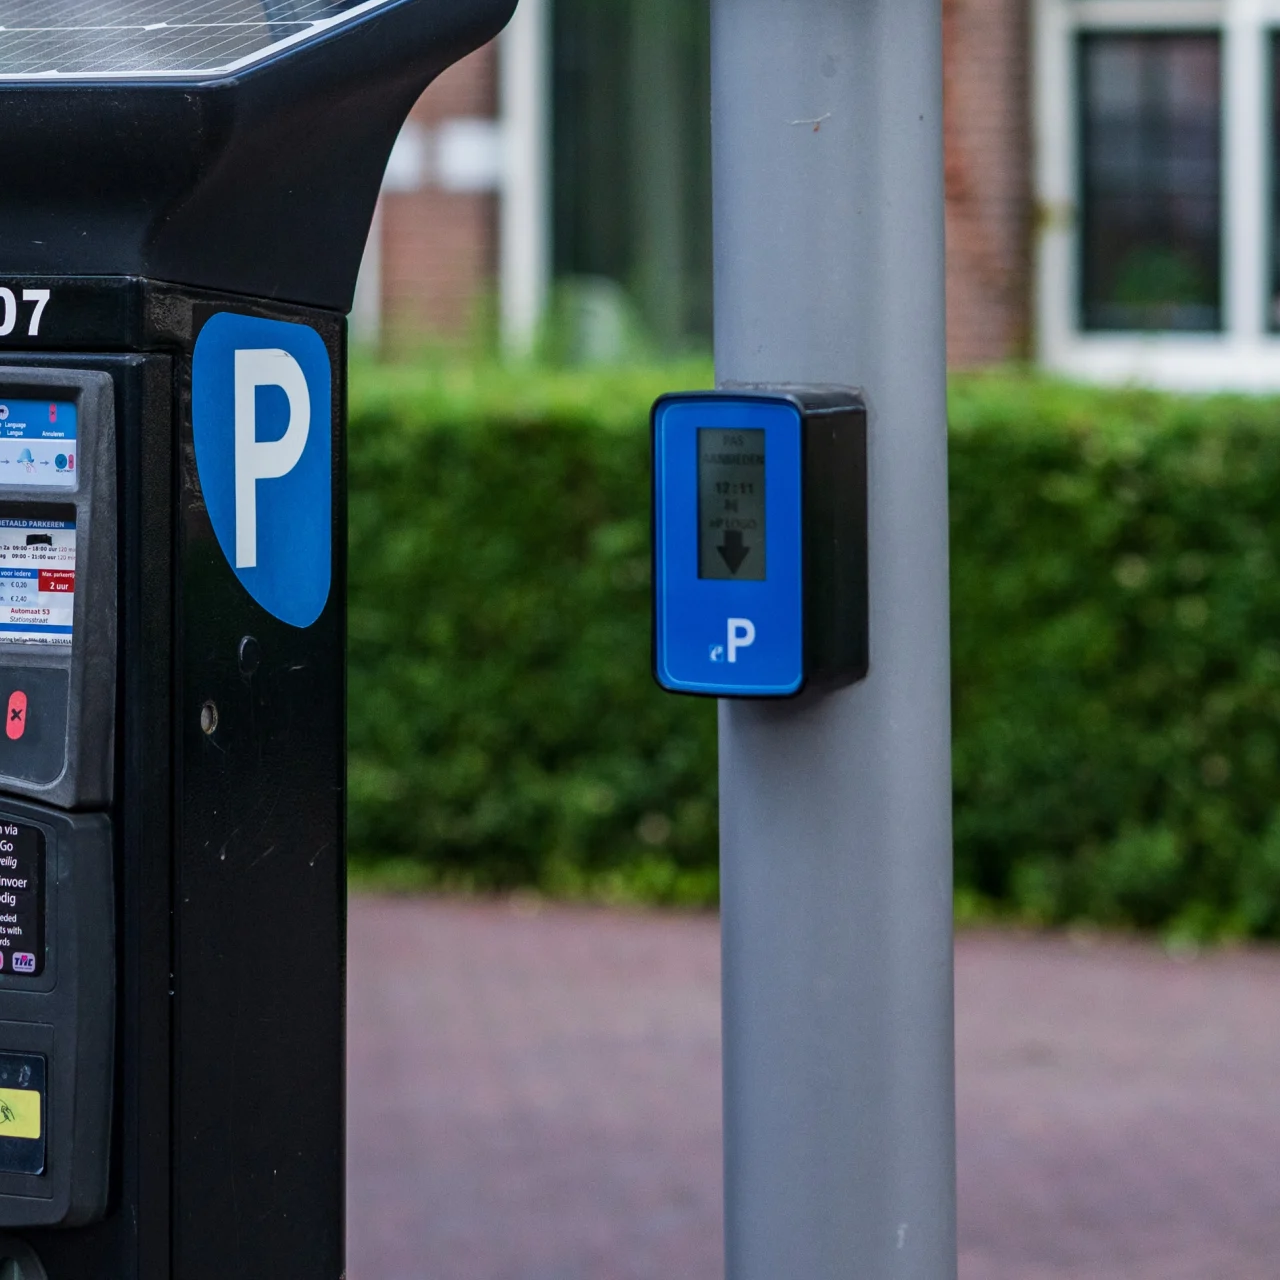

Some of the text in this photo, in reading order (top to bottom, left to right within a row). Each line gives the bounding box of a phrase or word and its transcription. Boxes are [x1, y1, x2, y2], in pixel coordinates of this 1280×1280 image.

[4, 421, 26, 429] Language
[6, 429, 23, 437] Langue
[234, 348, 311, 569] P
[28, 520, 65, 528] PARKEREN
[49, 582, 55, 590] 2
[9, 616, 48, 624] Stationsstraat
[4, 824, 18, 835] via
[0, 840, 13, 851] Go
[7, 925, 22, 935] with
